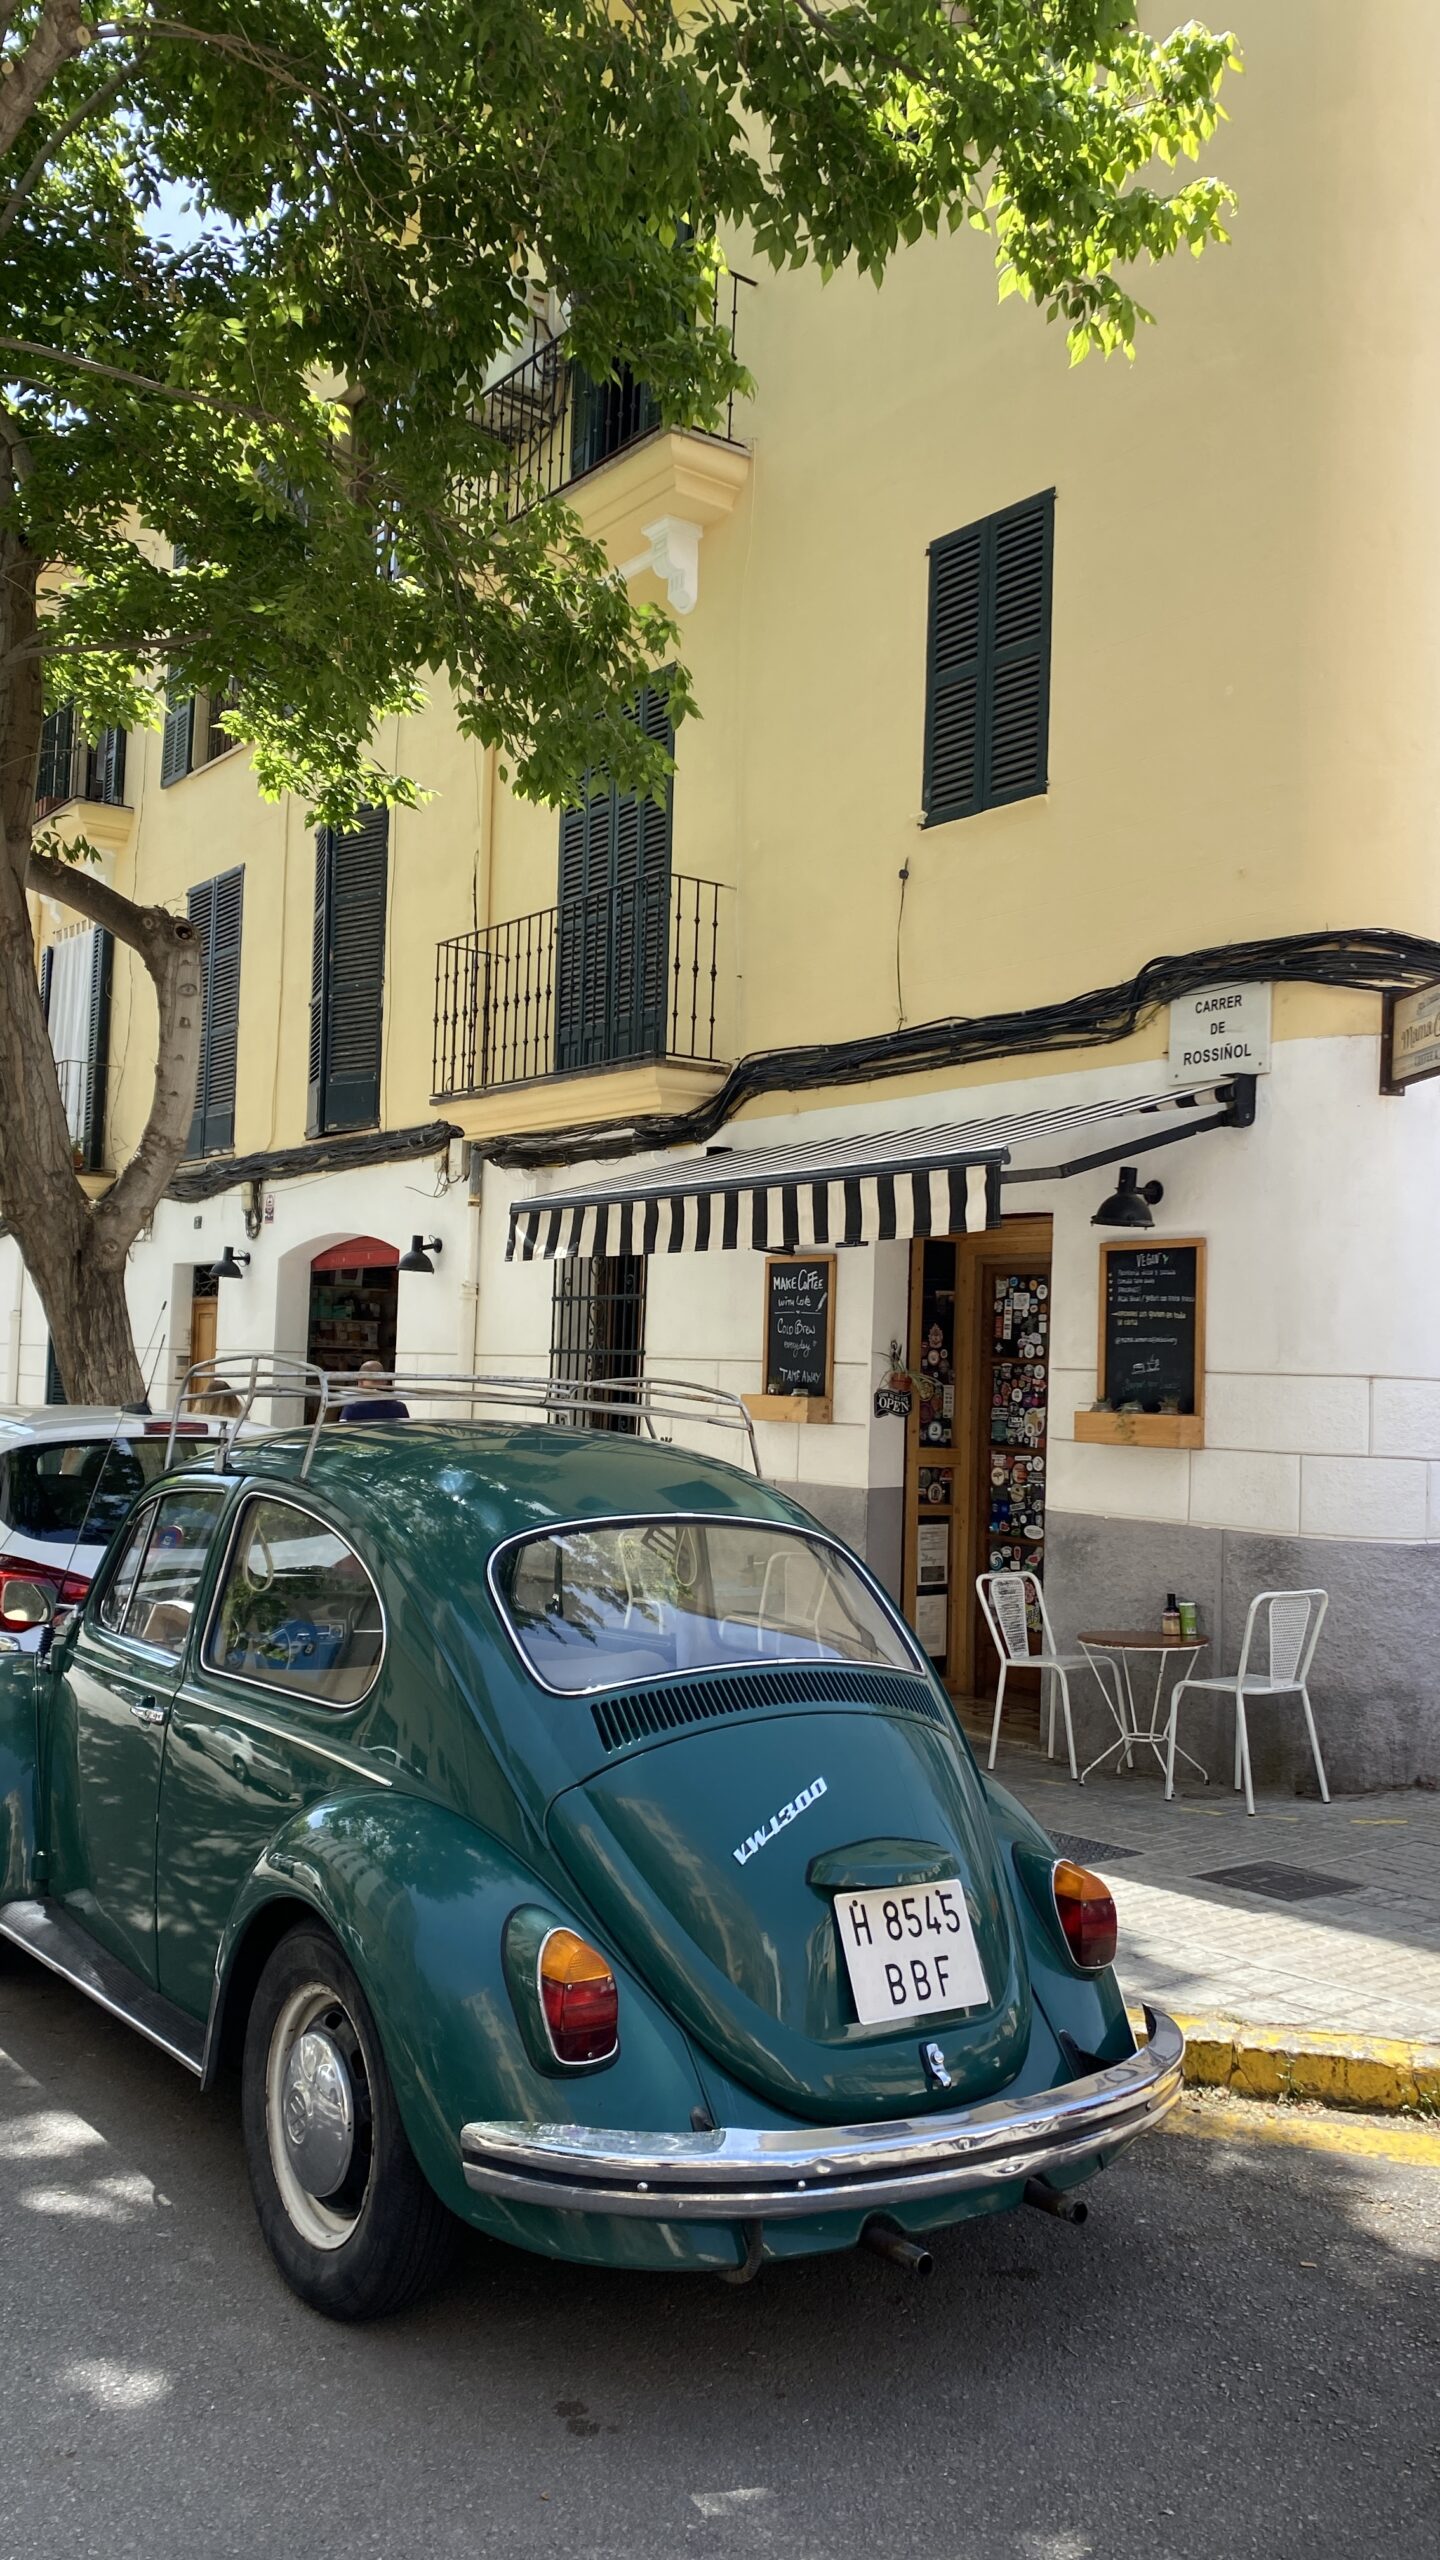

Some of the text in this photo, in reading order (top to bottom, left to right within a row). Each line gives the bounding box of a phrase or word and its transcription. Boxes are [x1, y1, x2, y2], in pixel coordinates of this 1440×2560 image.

[1195, 994, 1242, 1014] CARRER
[1210, 1021, 1226, 1035] DE
[1183, 1042, 1252, 1066] ROSSIÑOL
[773, 1276, 797, 1291] MAKE
[879, 1397, 909, 1412] OPEN
[849, 1892, 961, 1947] H 8545
[884, 1954, 949, 2006] BBF
